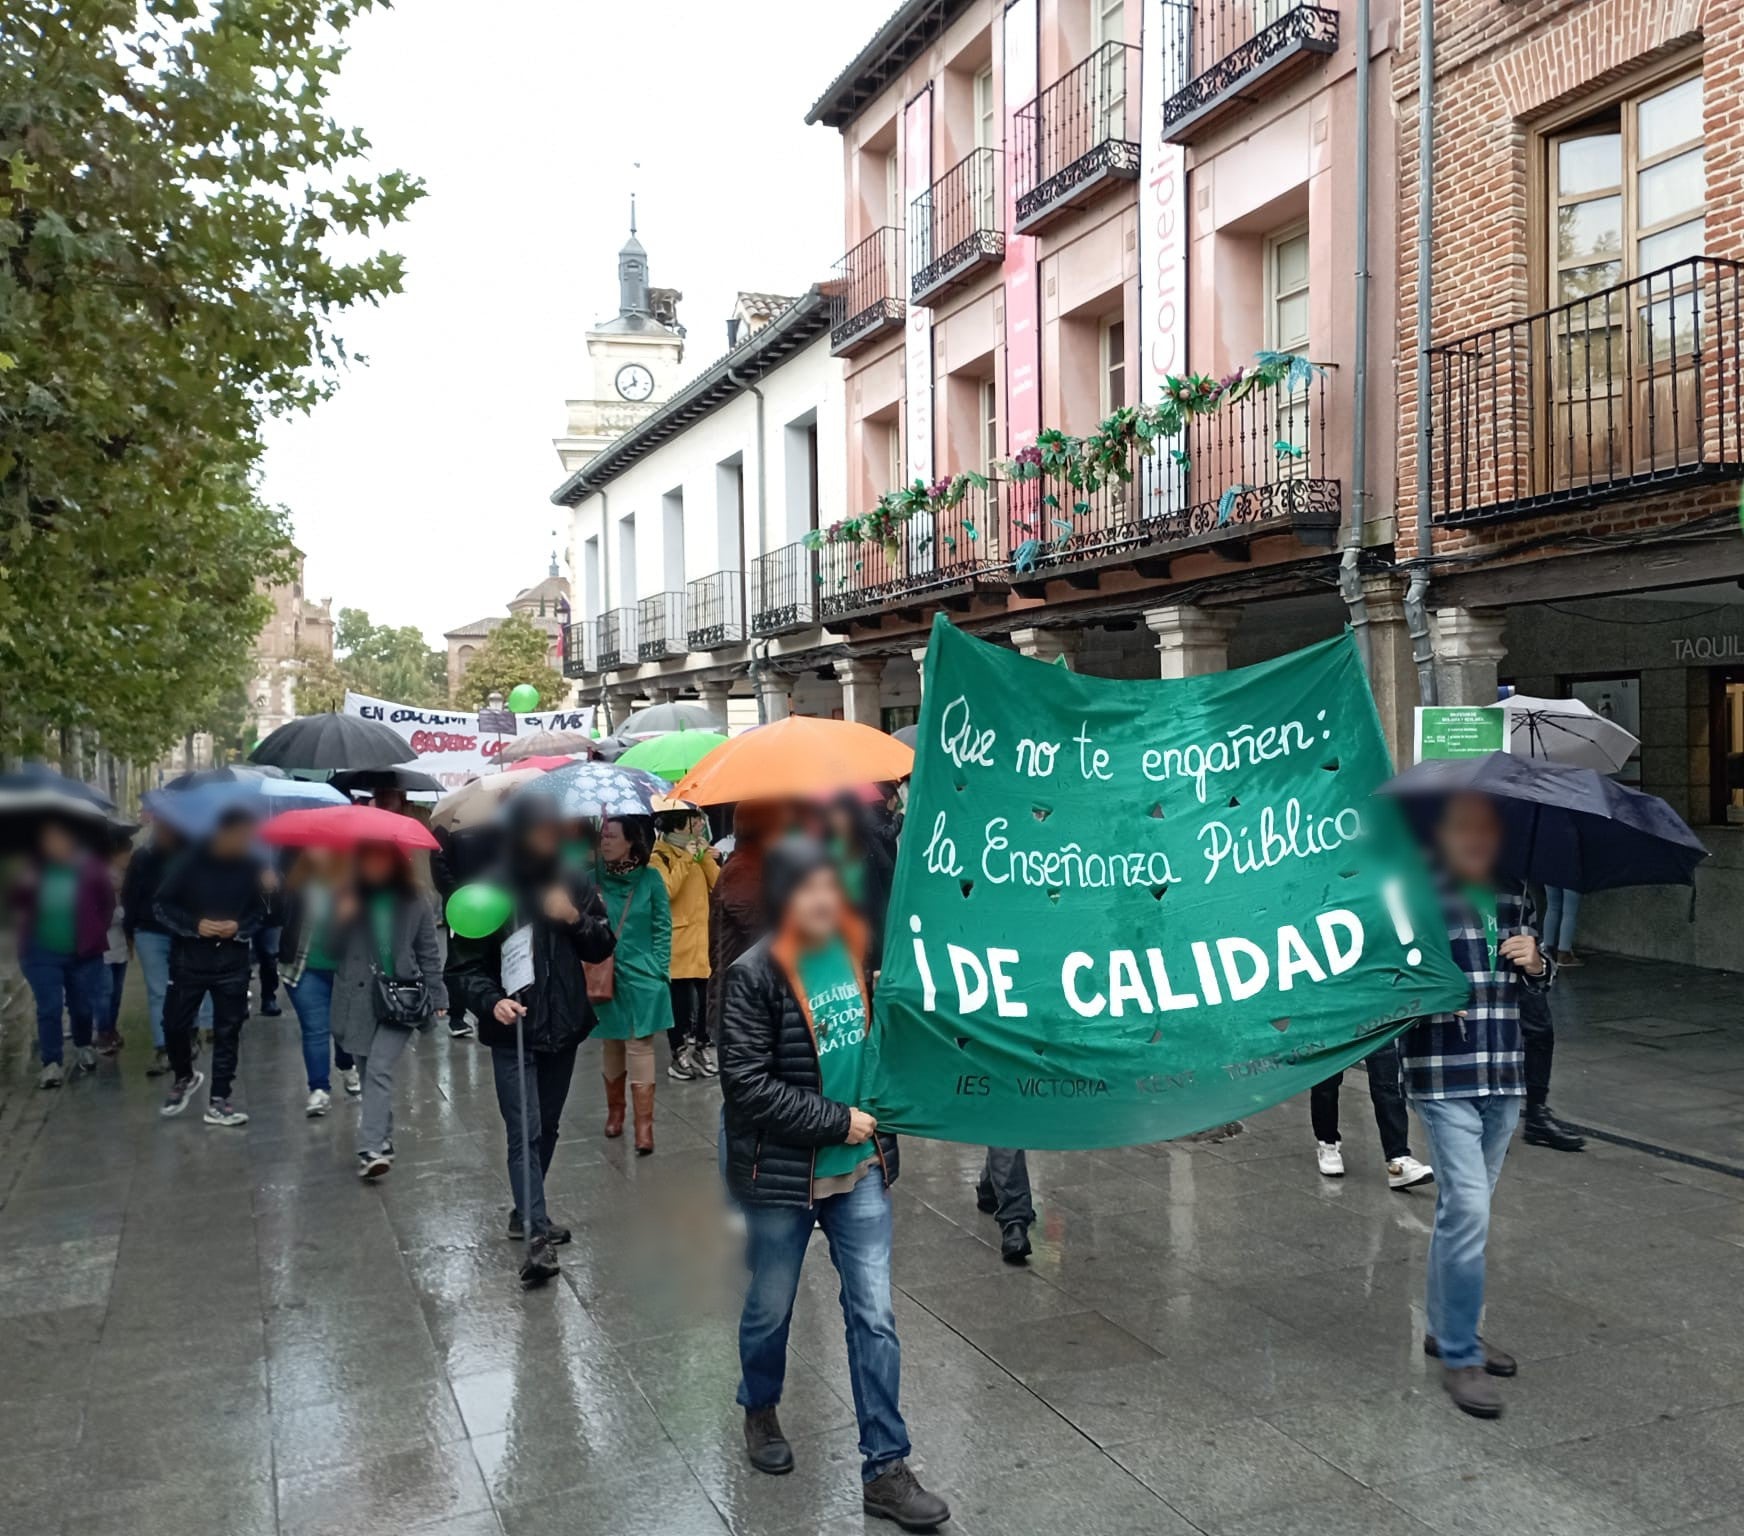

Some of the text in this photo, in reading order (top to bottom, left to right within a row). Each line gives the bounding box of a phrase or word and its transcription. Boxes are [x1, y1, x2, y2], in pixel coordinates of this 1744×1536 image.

[360, 706, 384, 721] EN
[941, 694, 995, 769] Que
[1015, 739, 1060, 777] no
[1074, 720, 1114, 780] te
[923, 810, 963, 878] la
[981, 817, 1182, 888] Enseñanza
[956, 1074, 991, 1097] IES
[1016, 1077, 1113, 1099] VICTORIA
